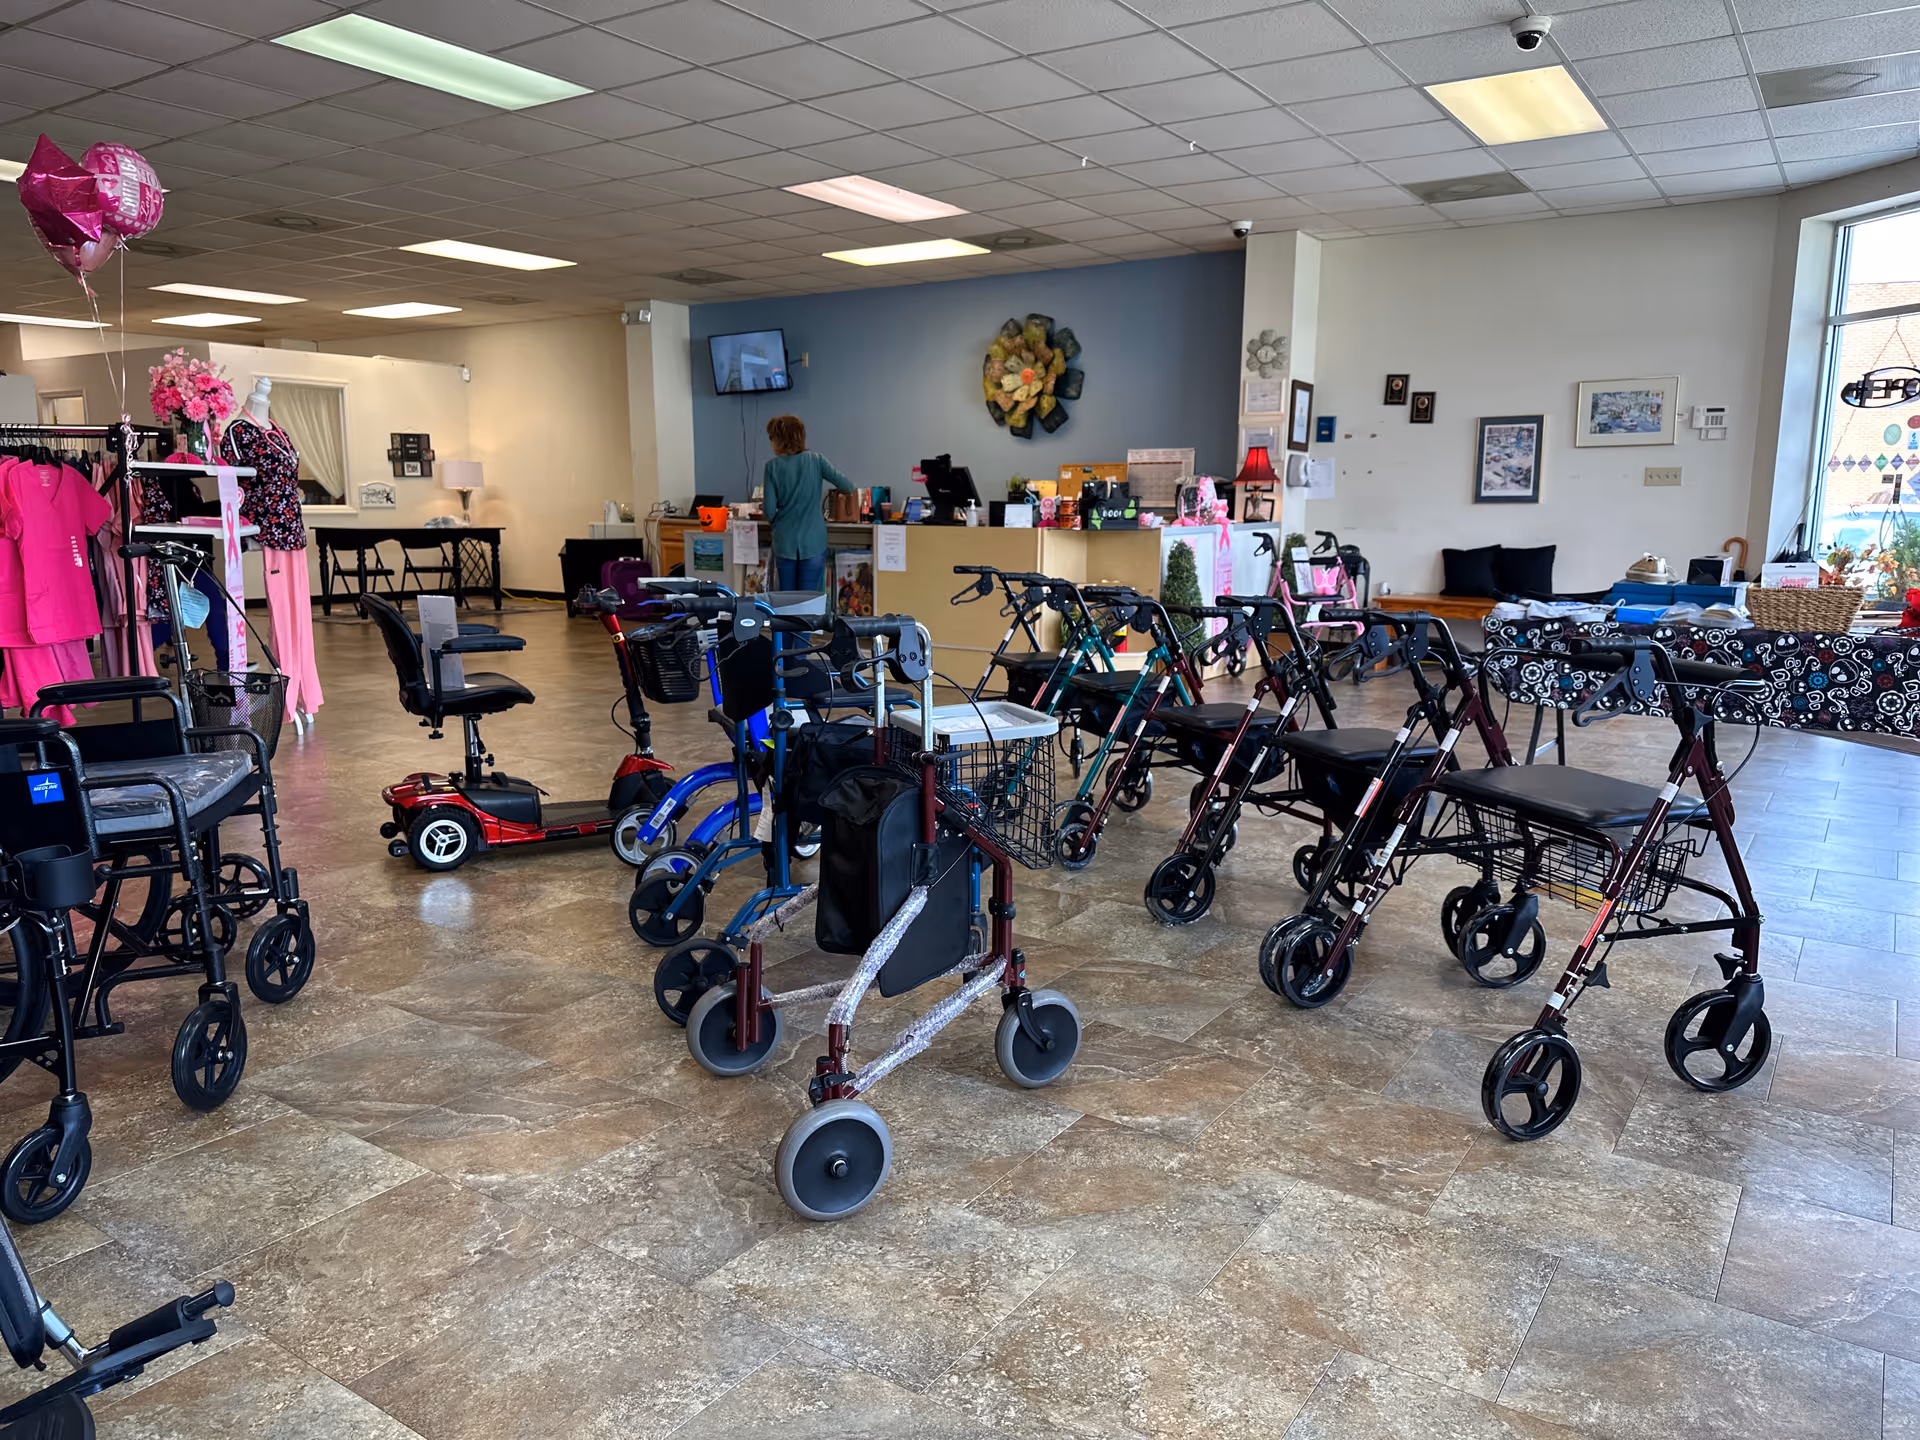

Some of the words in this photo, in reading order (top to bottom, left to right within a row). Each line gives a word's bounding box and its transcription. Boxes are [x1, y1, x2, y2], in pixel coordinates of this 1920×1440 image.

[119, 154, 139, 217] COURAGE
[140, 187, 152, 221] Love
[32, 783, 58, 792] MEDLINE
